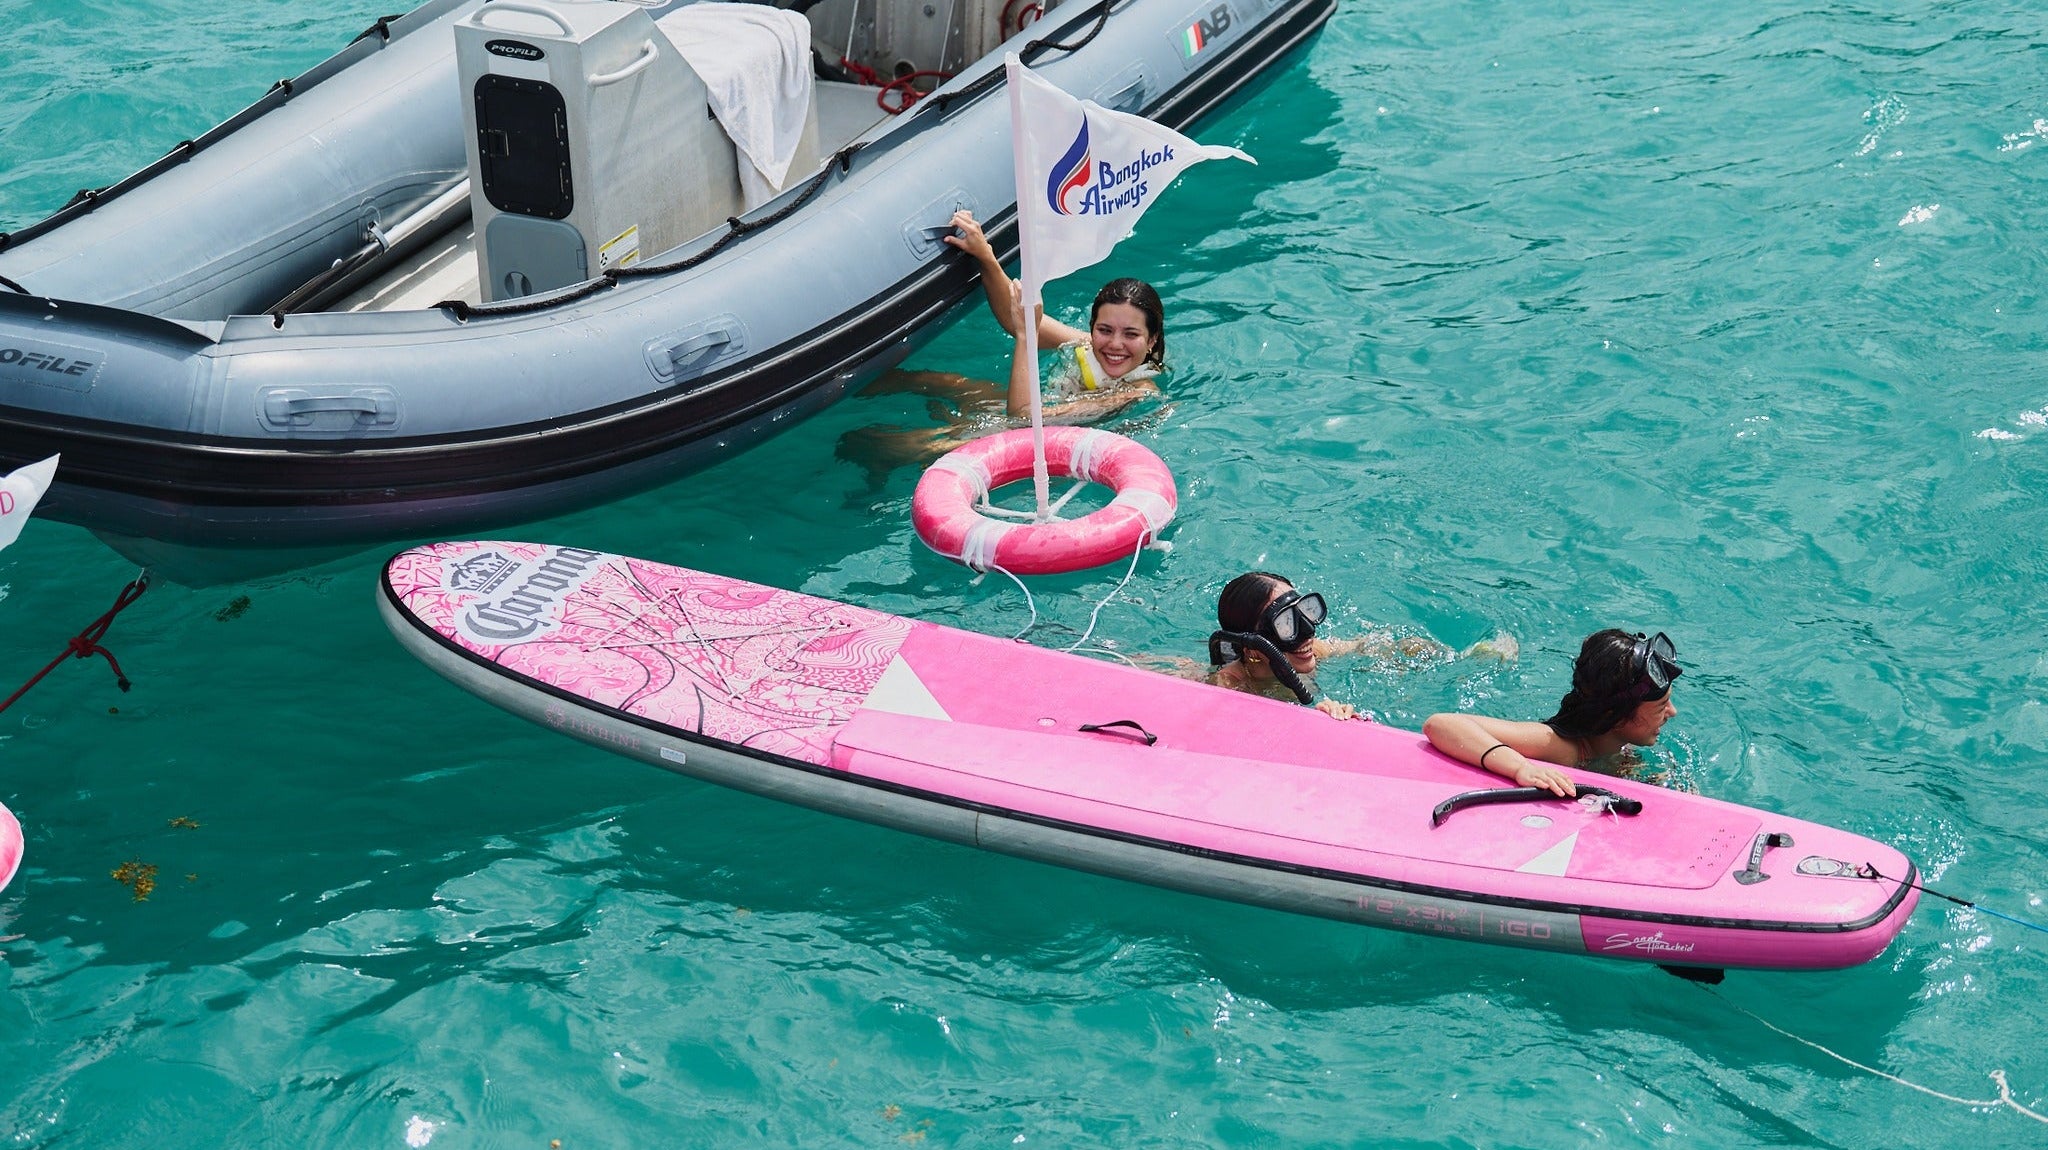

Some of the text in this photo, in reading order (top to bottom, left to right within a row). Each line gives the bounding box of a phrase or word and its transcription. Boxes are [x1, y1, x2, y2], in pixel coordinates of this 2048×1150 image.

[1199, 3, 1231, 47] AB
[1099, 144, 1174, 190] Bangkok
[1079, 180, 1148, 215] Airways
[465, 548, 602, 639] Corona
[1500, 919, 1551, 939] iGO
